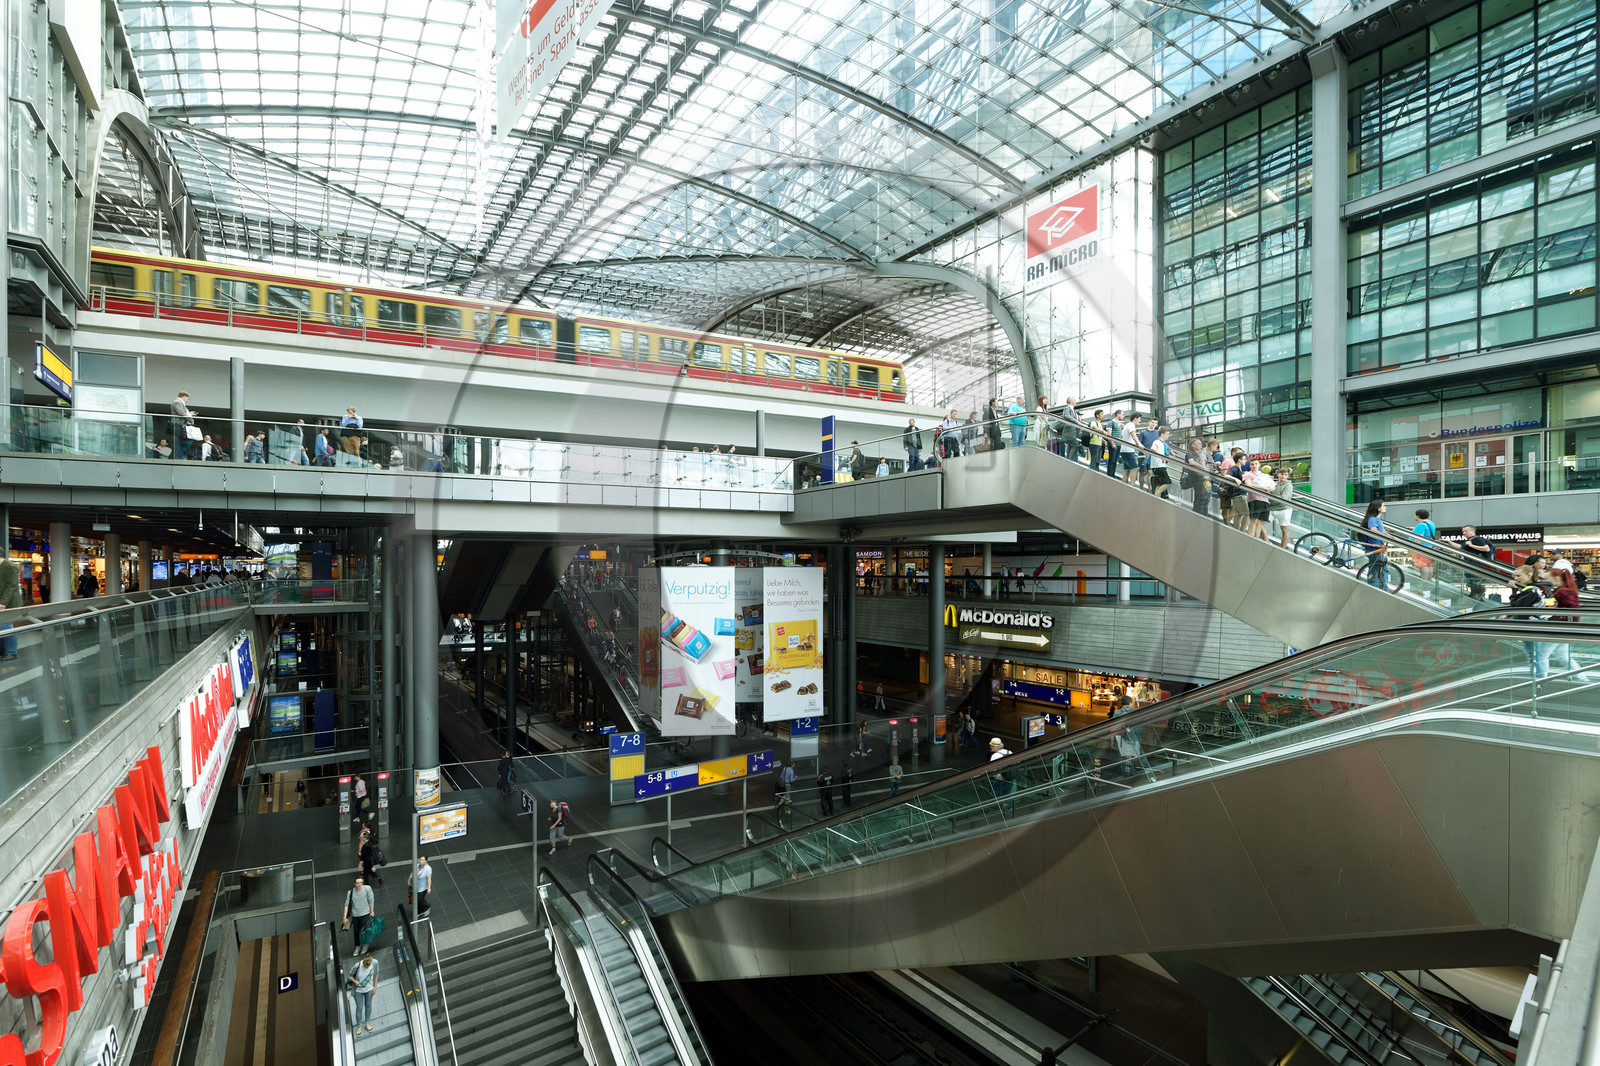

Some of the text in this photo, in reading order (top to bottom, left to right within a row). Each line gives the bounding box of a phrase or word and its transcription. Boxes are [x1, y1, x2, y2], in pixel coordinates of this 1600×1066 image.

[507, 6, 575, 97] Wenns um Geld
[1441, 417, 1544, 438] Bundespolizei
[767, 578, 801, 587] Liebe Milch,
[665, 580, 731, 600] Verputzig!
[767, 589, 776, 597] wir
[777, 588, 795, 597] haben
[767, 597, 820, 608] Besseres gefunden.
[960, 608, 1053, 629] McDonald's
[1036, 672, 1062, 685] SALE
[796, 717, 811, 729] 1-2
[1044, 713, 1062, 724] 4 3
[620, 734, 640, 747] 7-8
[753, 752, 764, 762] 1-4
[647, 772, 662, 784] 5-8
[522, 793, 526, 807] 6
[0, 745, 170, 1066] SMANN
[280, 976, 292, 990] D
